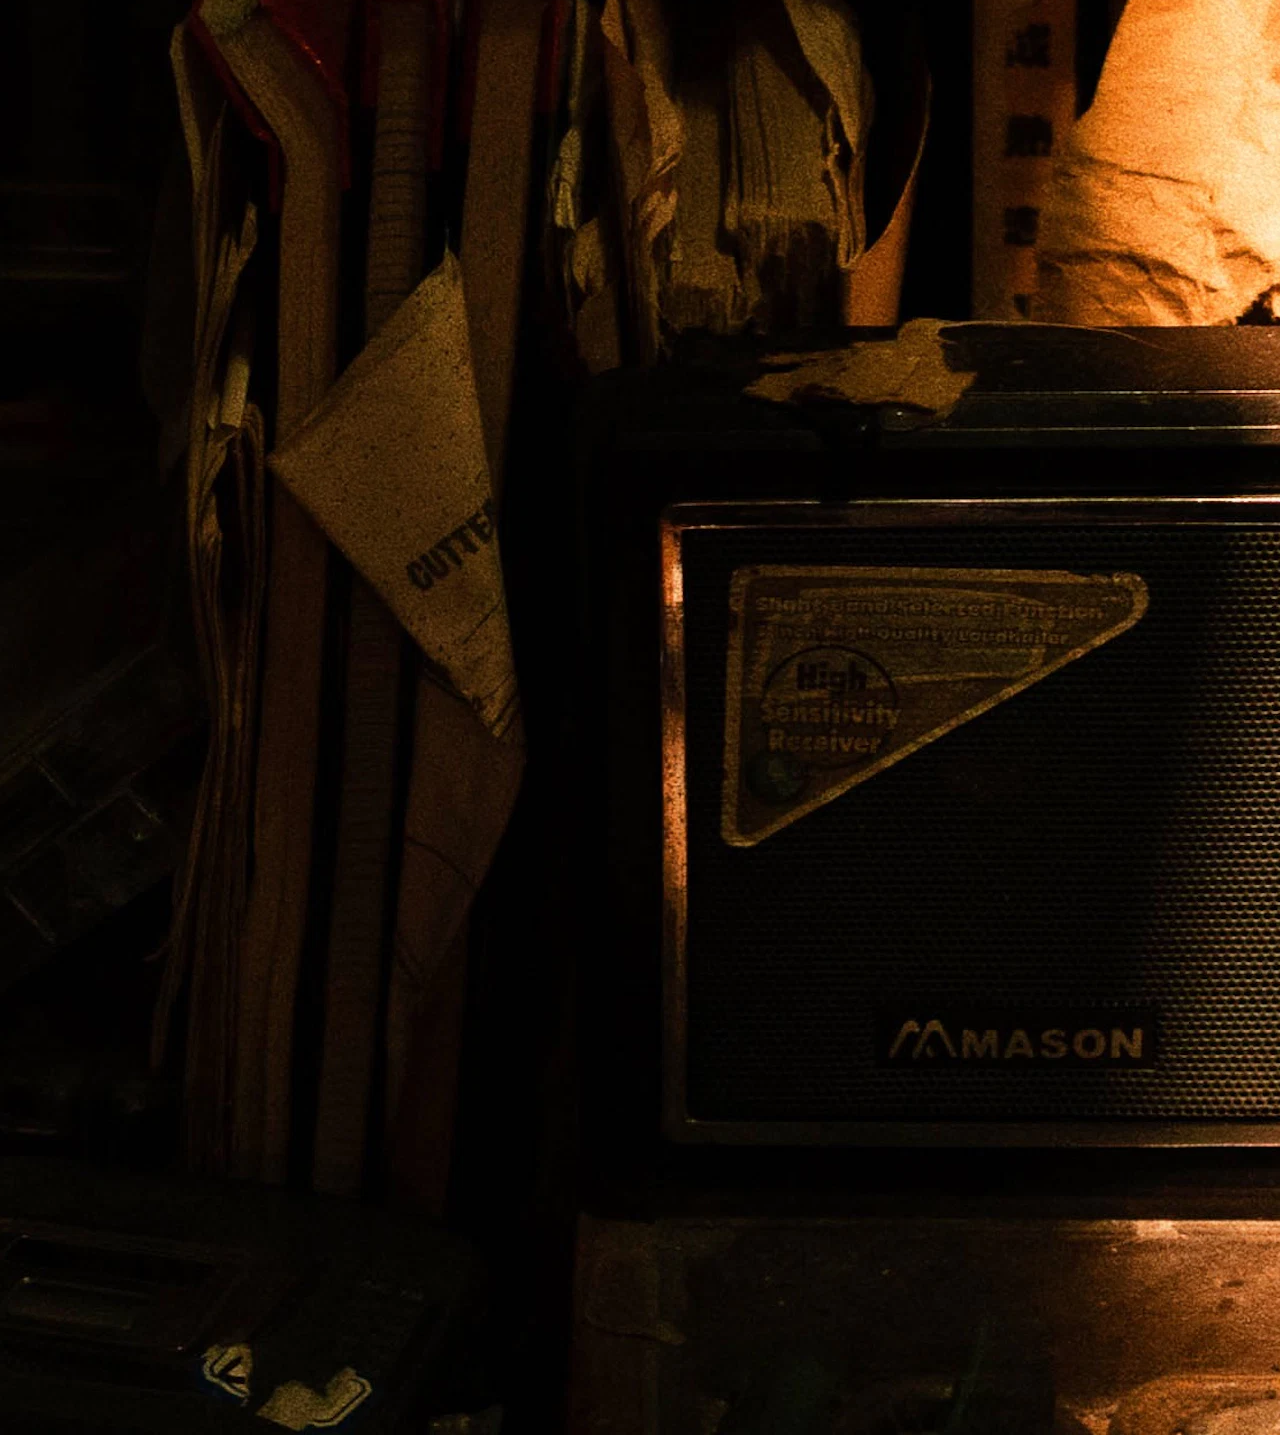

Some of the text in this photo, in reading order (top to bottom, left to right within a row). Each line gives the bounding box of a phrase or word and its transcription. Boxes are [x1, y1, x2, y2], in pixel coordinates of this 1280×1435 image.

[797, 660, 868, 694] High
[760, 700, 902, 731] Sensitivity
[768, 728, 883, 754] Receiver
[961, 1026, 1145, 1059] MASON
